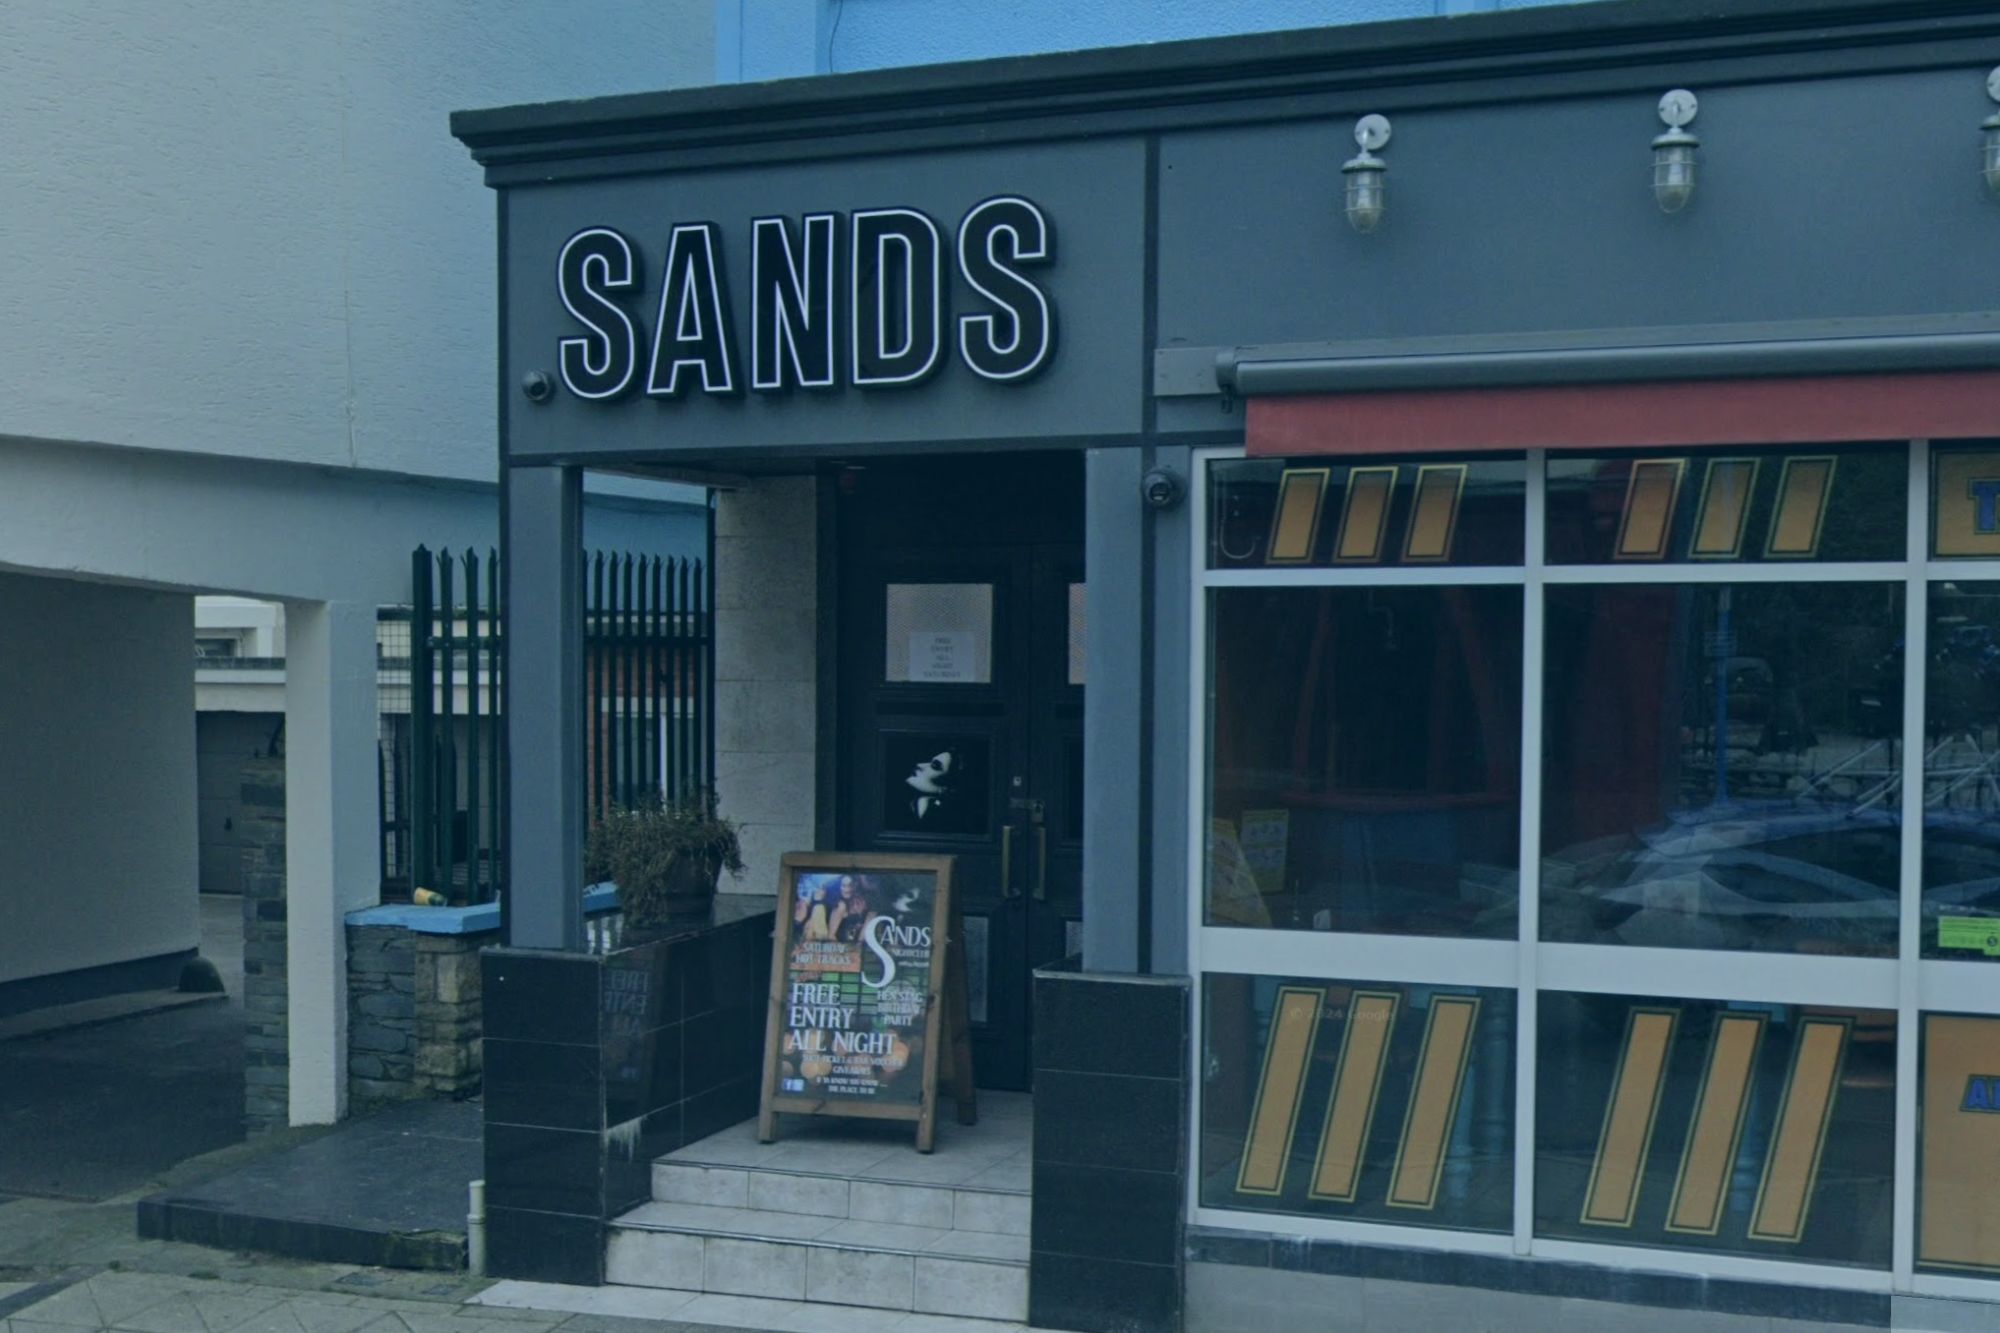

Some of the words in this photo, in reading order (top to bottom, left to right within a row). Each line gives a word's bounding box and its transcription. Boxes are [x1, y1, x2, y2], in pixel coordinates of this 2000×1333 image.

[557, 195, 1054, 400] SANDS
[861, 915, 931, 988] SANDS
[792, 983, 840, 1005] FREE
[790, 1007, 854, 1030] ENTRY
[787, 1030, 826, 1052] ALL
[832, 1031, 897, 1055] NIGHT
